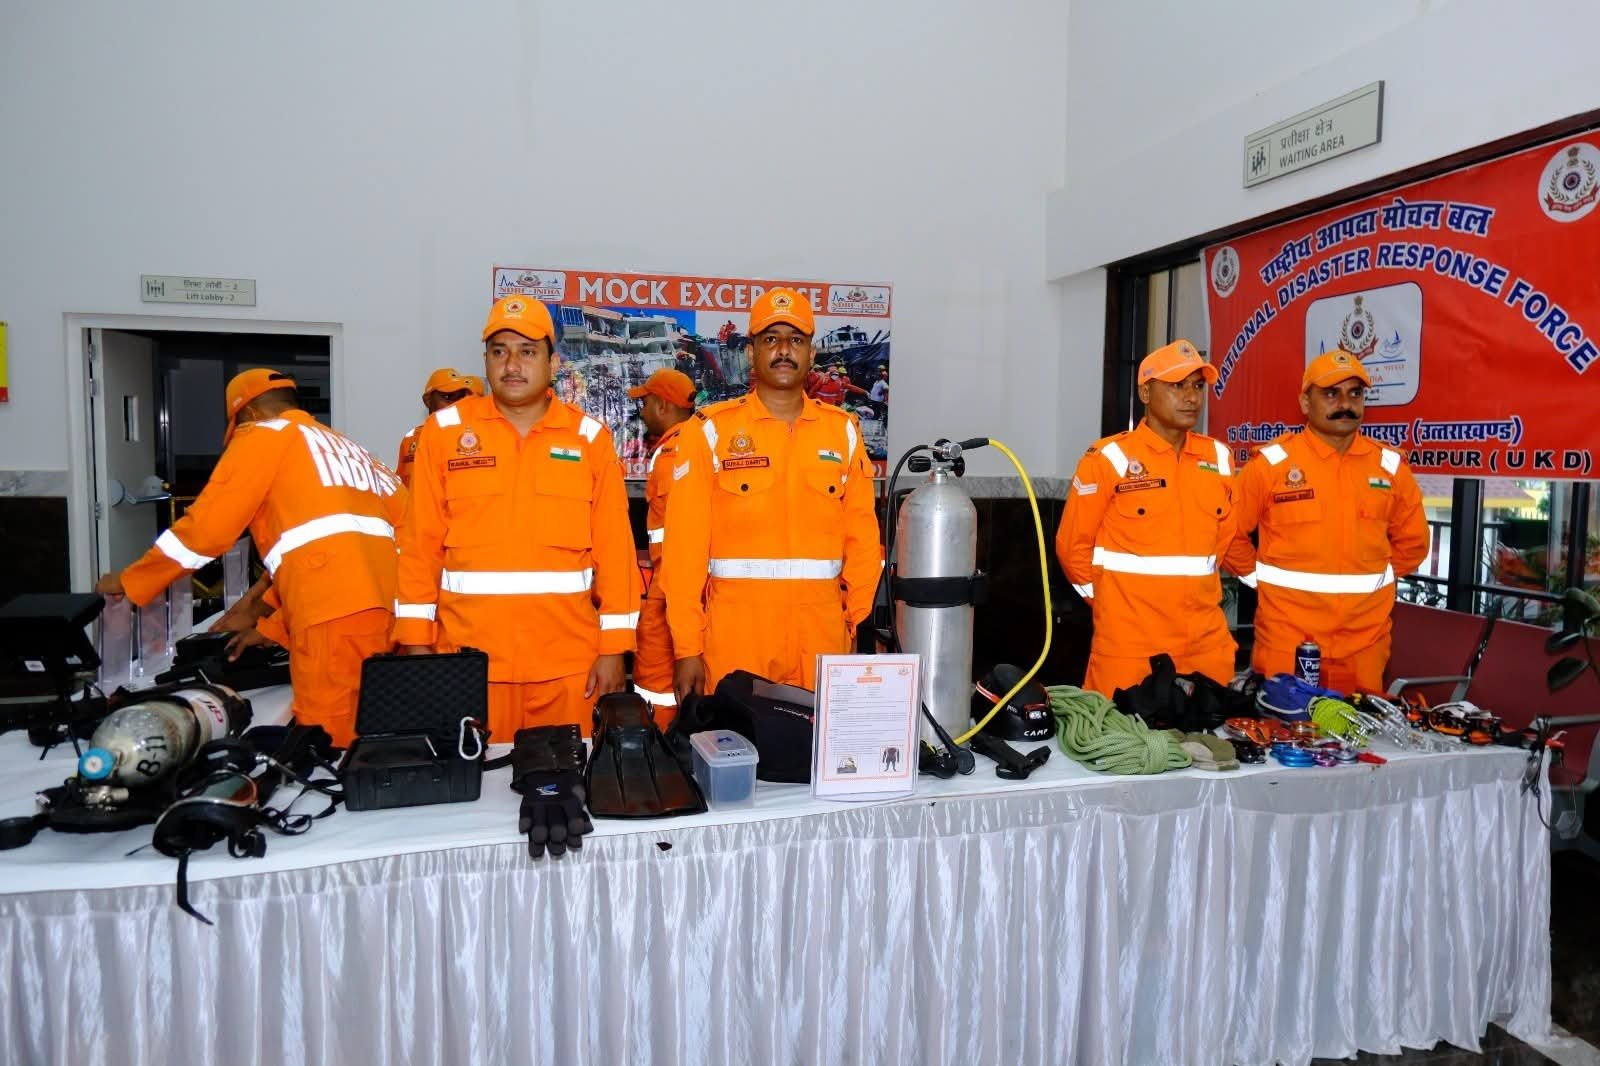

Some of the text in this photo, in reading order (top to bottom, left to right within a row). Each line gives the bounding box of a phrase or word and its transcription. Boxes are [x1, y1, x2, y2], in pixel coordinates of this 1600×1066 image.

[1280, 118, 1333, 149] प्रतीक्षा क्षेत्र
[1280, 134, 1345, 168] WAITING AREA
[1260, 198, 1493, 284] राष्ट्रीय आपदा मोचन बल
[200, 293, 224, 302] Lobby
[577, 276, 670, 305] MOCK
[1213, 244, 1598, 397] NATIONAL DISASTER RESPONSE FORCE
[1507, 451, 1525, 468] U
[1534, 451, 1555, 469] K
[1024, 728, 1048, 737] CAMP
